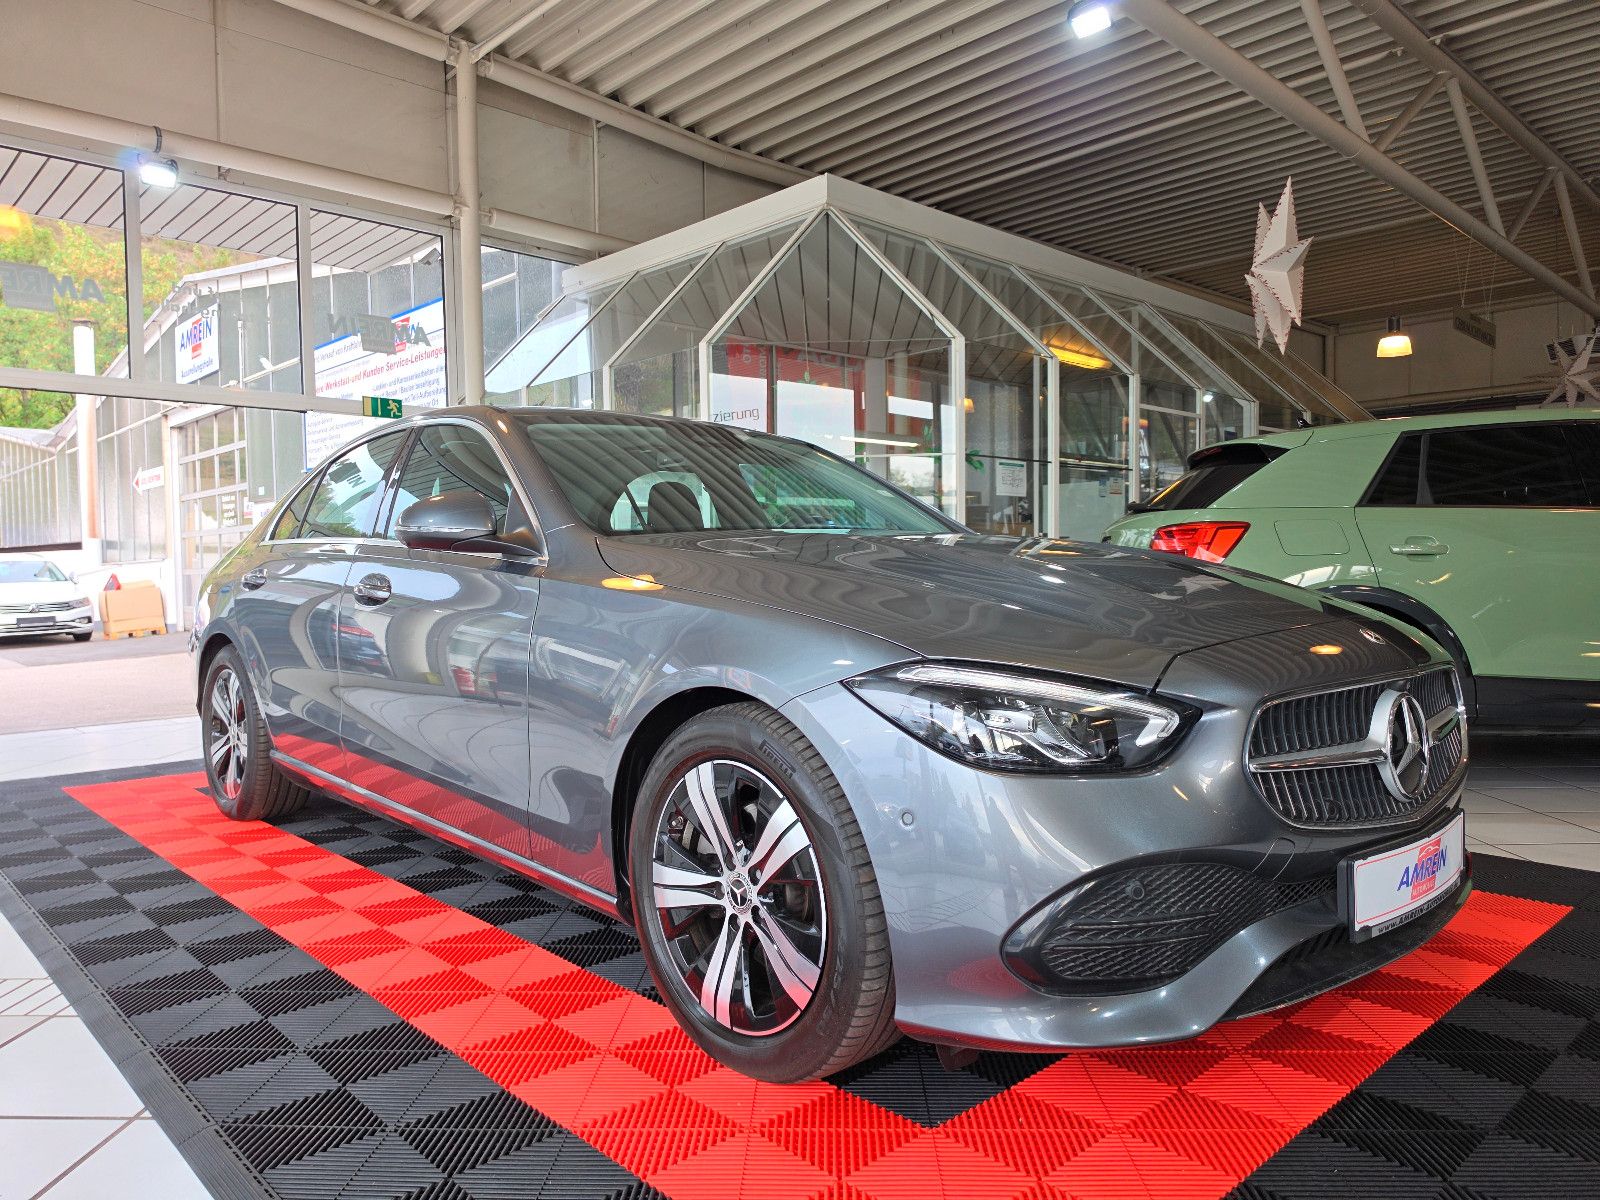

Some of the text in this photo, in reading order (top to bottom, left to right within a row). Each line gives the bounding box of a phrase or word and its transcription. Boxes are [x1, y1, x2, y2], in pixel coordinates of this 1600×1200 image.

[180, 319, 212, 352] AMREIN
[713, 408, 759, 423] zierung
[759, 739, 796, 779] PIRELLI
[1397, 845, 1447, 892] AMREIN
